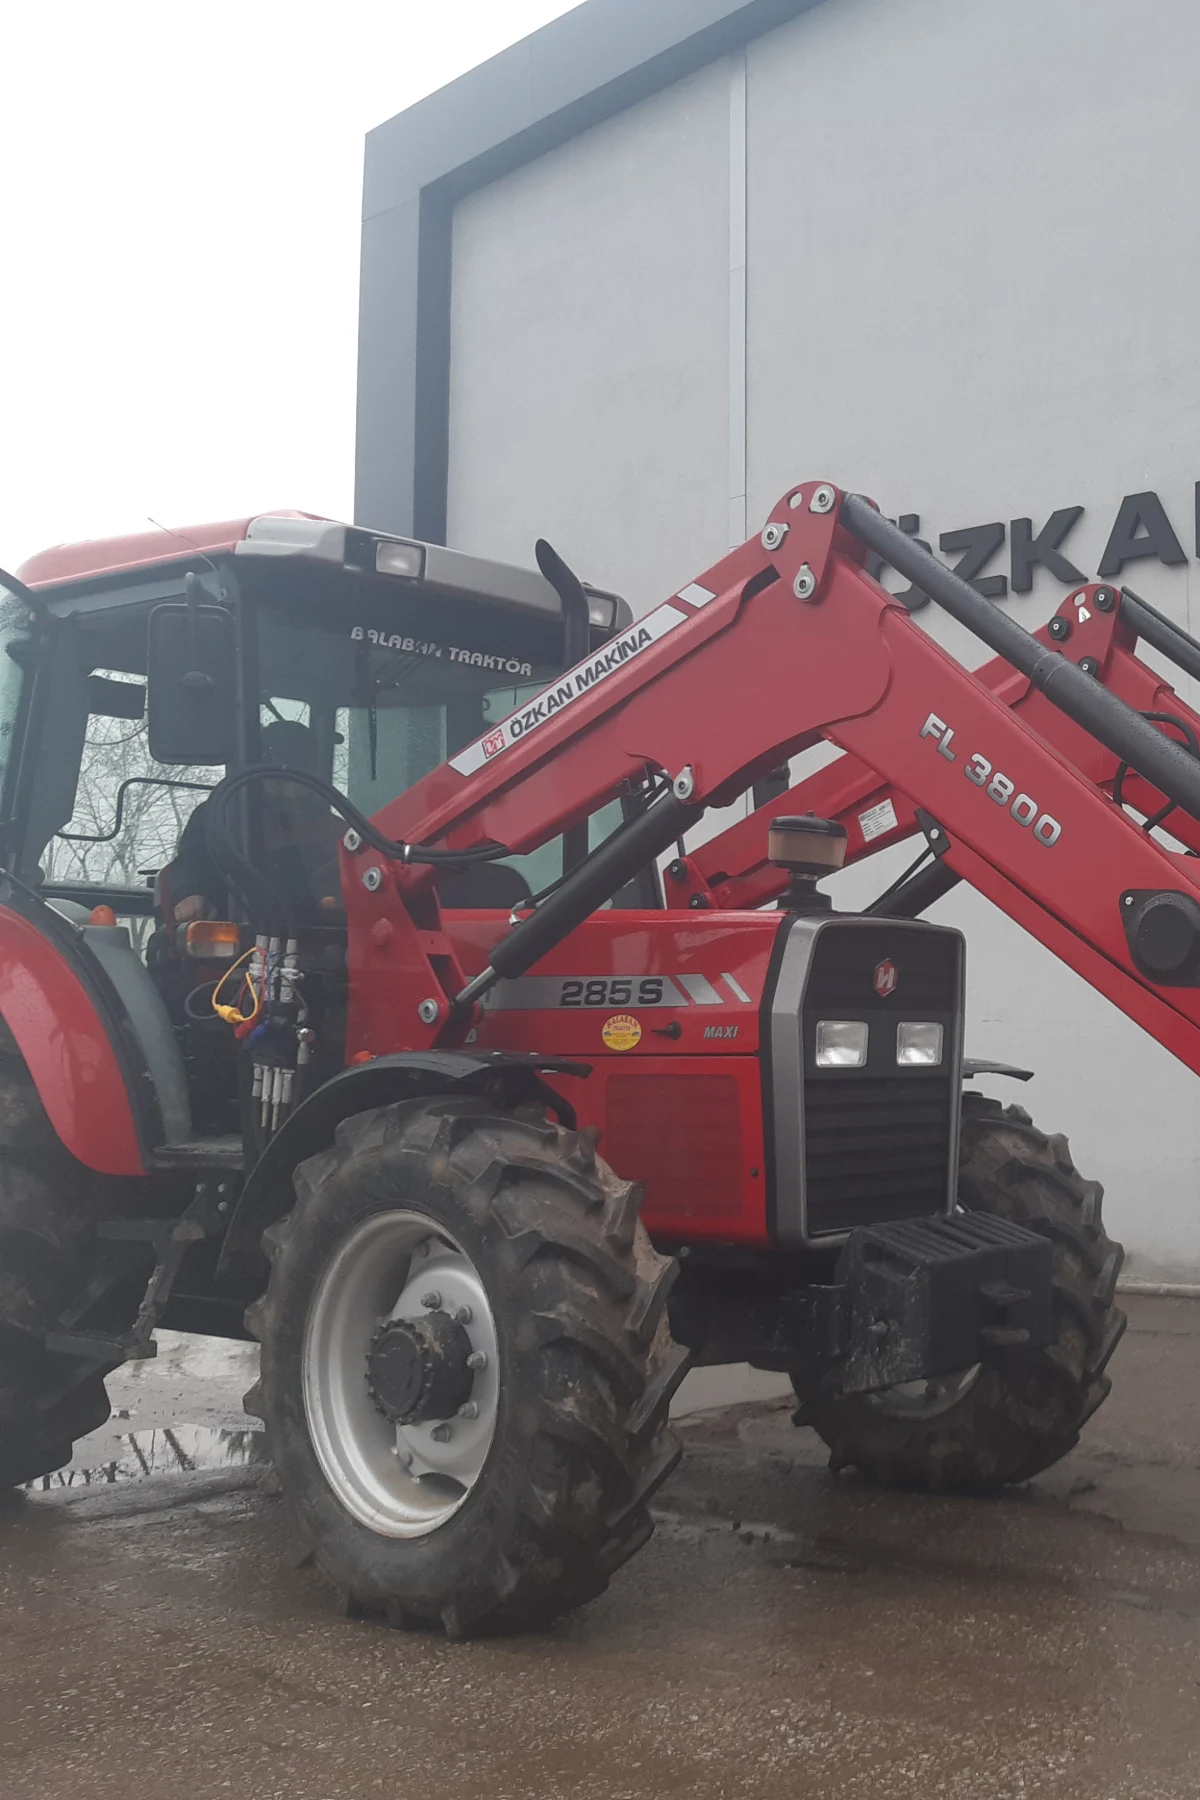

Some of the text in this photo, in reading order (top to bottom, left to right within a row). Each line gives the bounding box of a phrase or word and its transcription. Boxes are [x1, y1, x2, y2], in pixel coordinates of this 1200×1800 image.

[448, 645, 533, 677] TRAKTÖR
[509, 682, 574, 739] ÖZKAN
[574, 628, 653, 692] MAKİNA
[919, 712, 956, 764] FL
[963, 752, 1063, 849] 3800
[559, 978, 663, 1006] 285 S
[703, 1025, 739, 1039] MAXI
